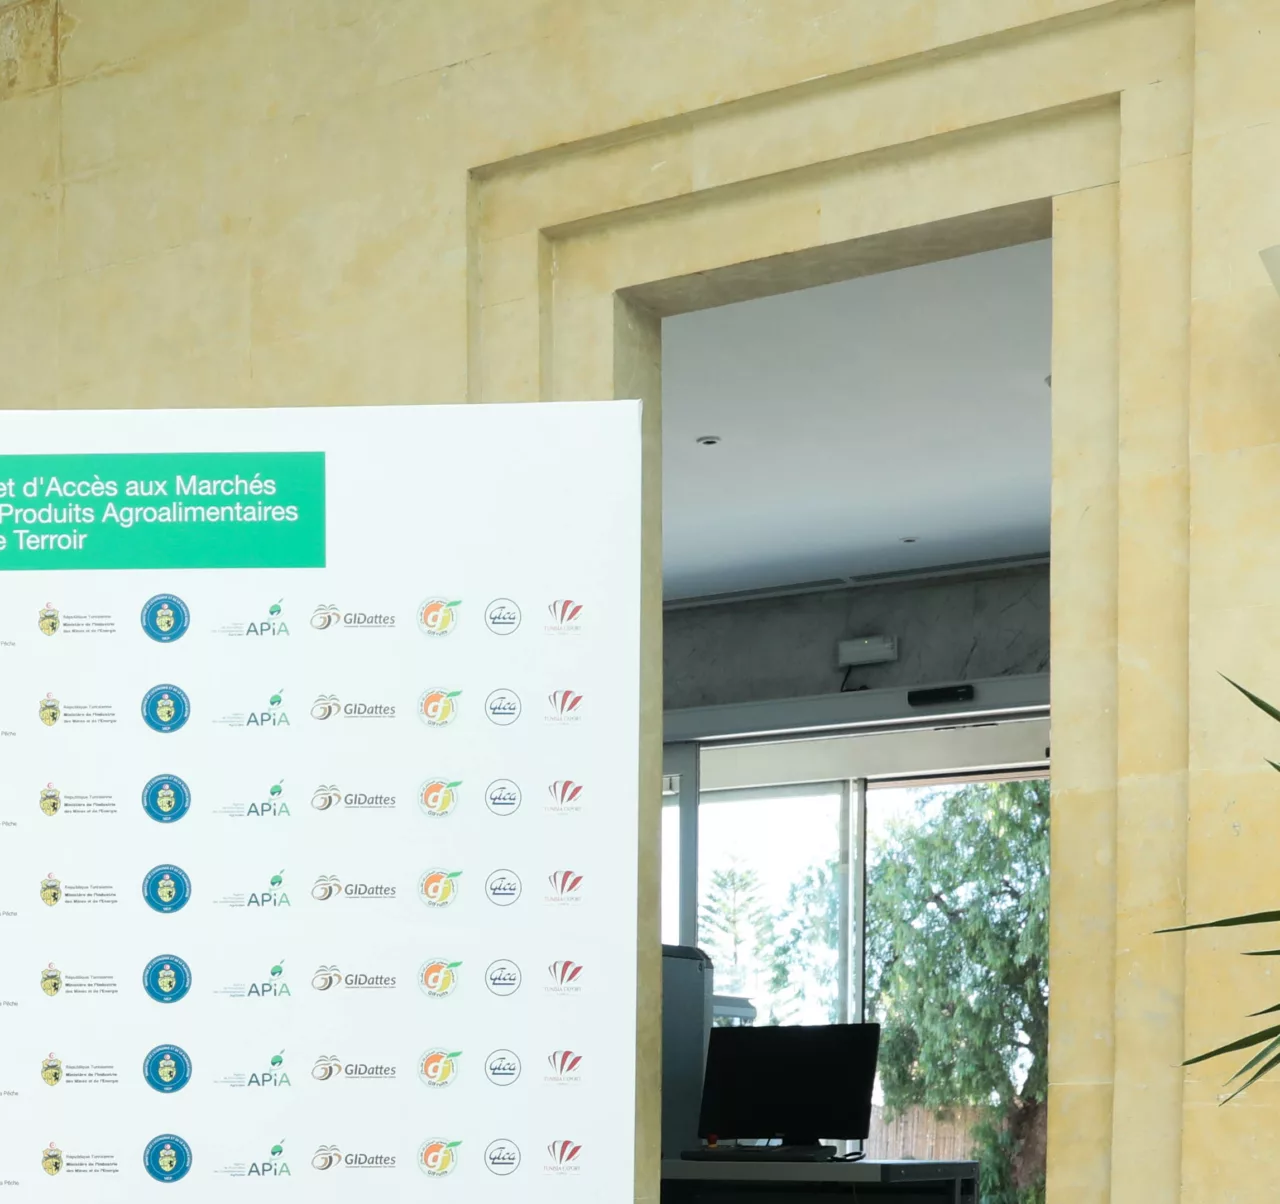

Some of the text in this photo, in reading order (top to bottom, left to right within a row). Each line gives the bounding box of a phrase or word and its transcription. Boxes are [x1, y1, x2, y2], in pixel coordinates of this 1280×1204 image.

[22, 474, 119, 498] d'Accès
[125, 479, 168, 497] aux
[176, 473, 277, 497] Marchés
[101, 501, 299, 528] Agroalimentaires
[13, 529, 88, 551] Terroir
[343, 612, 396, 625] GIDattes
[344, 702, 396, 715] GIDattes
[344, 793, 396, 805] GIDattes
[344, 883, 397, 896] GIDattes
[344, 973, 397, 986] GIDattes
[344, 1063, 397, 1076] GIDattes
[344, 1153, 396, 1165] GIDattes
